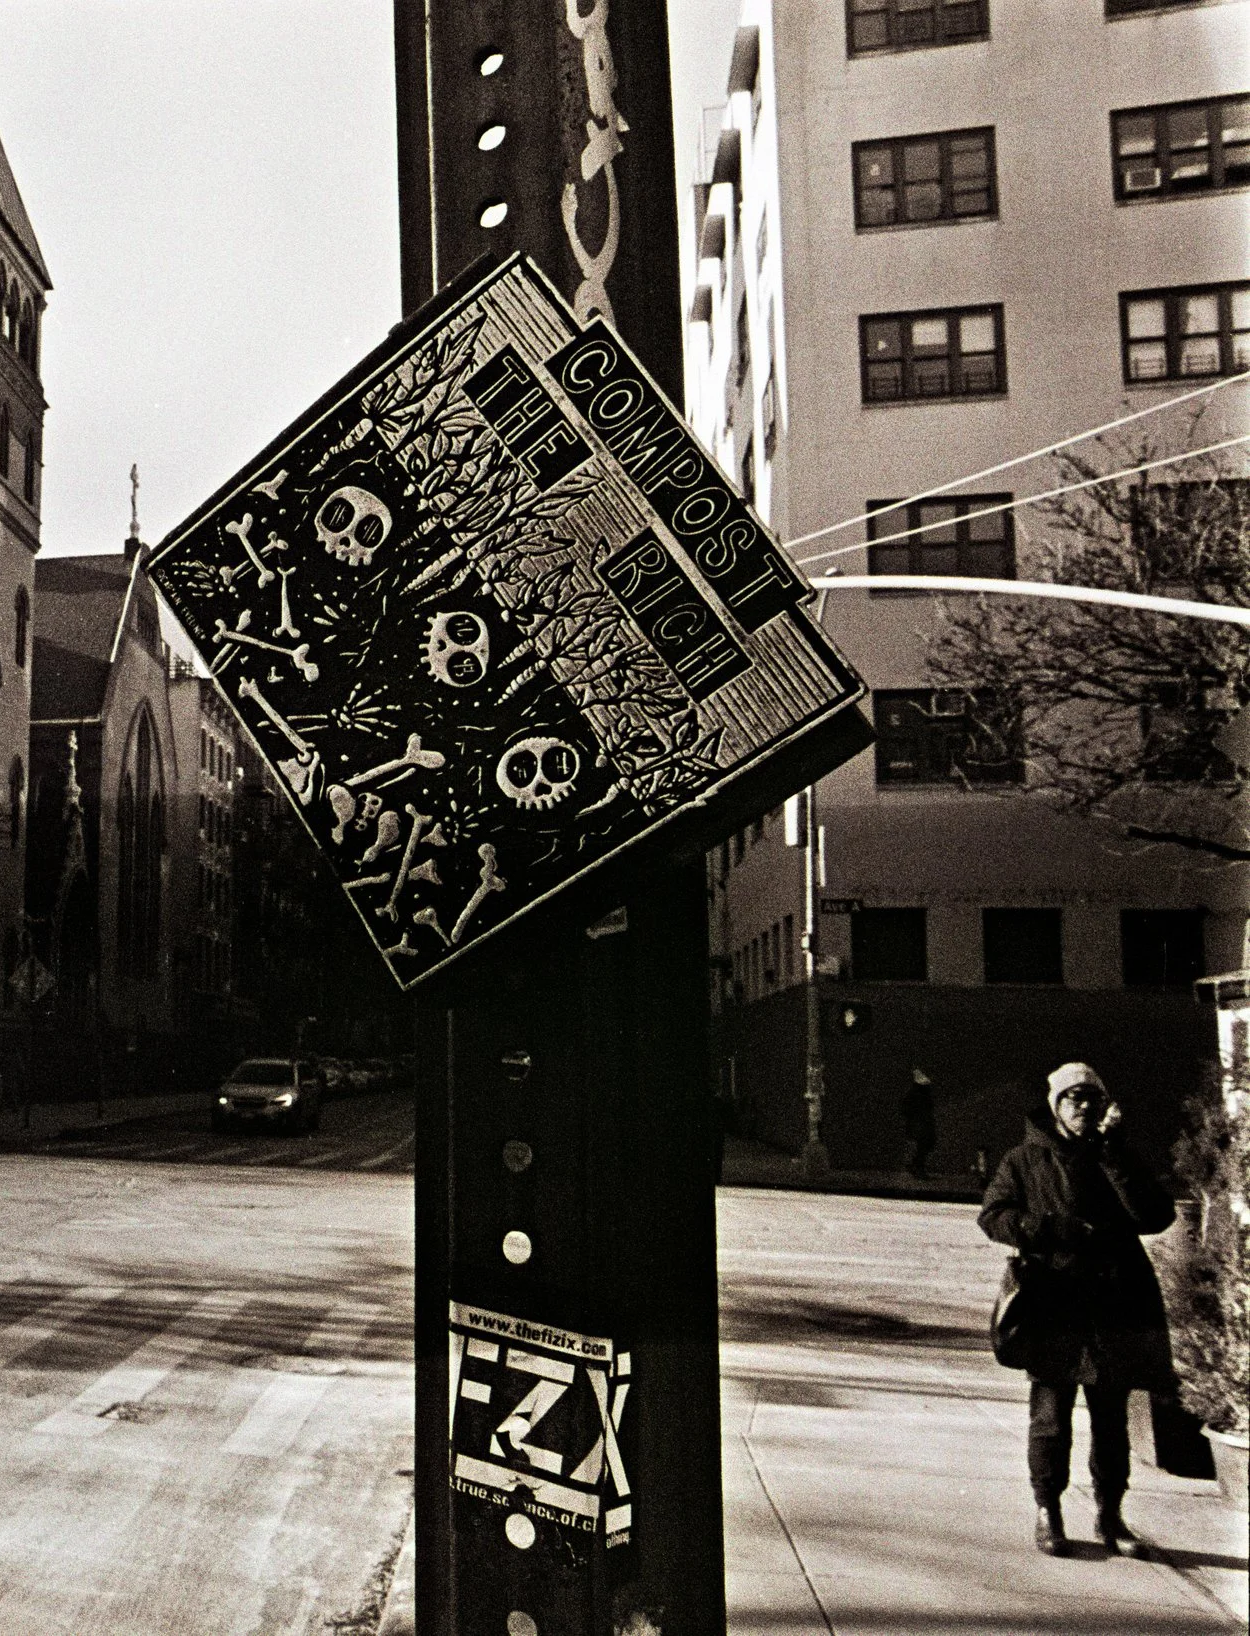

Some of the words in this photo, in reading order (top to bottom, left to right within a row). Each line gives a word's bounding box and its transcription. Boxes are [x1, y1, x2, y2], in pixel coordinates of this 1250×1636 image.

[475, 355, 578, 479] THE
[608, 540, 738, 690] RICH
[561, 339, 792, 609] COMPOST
